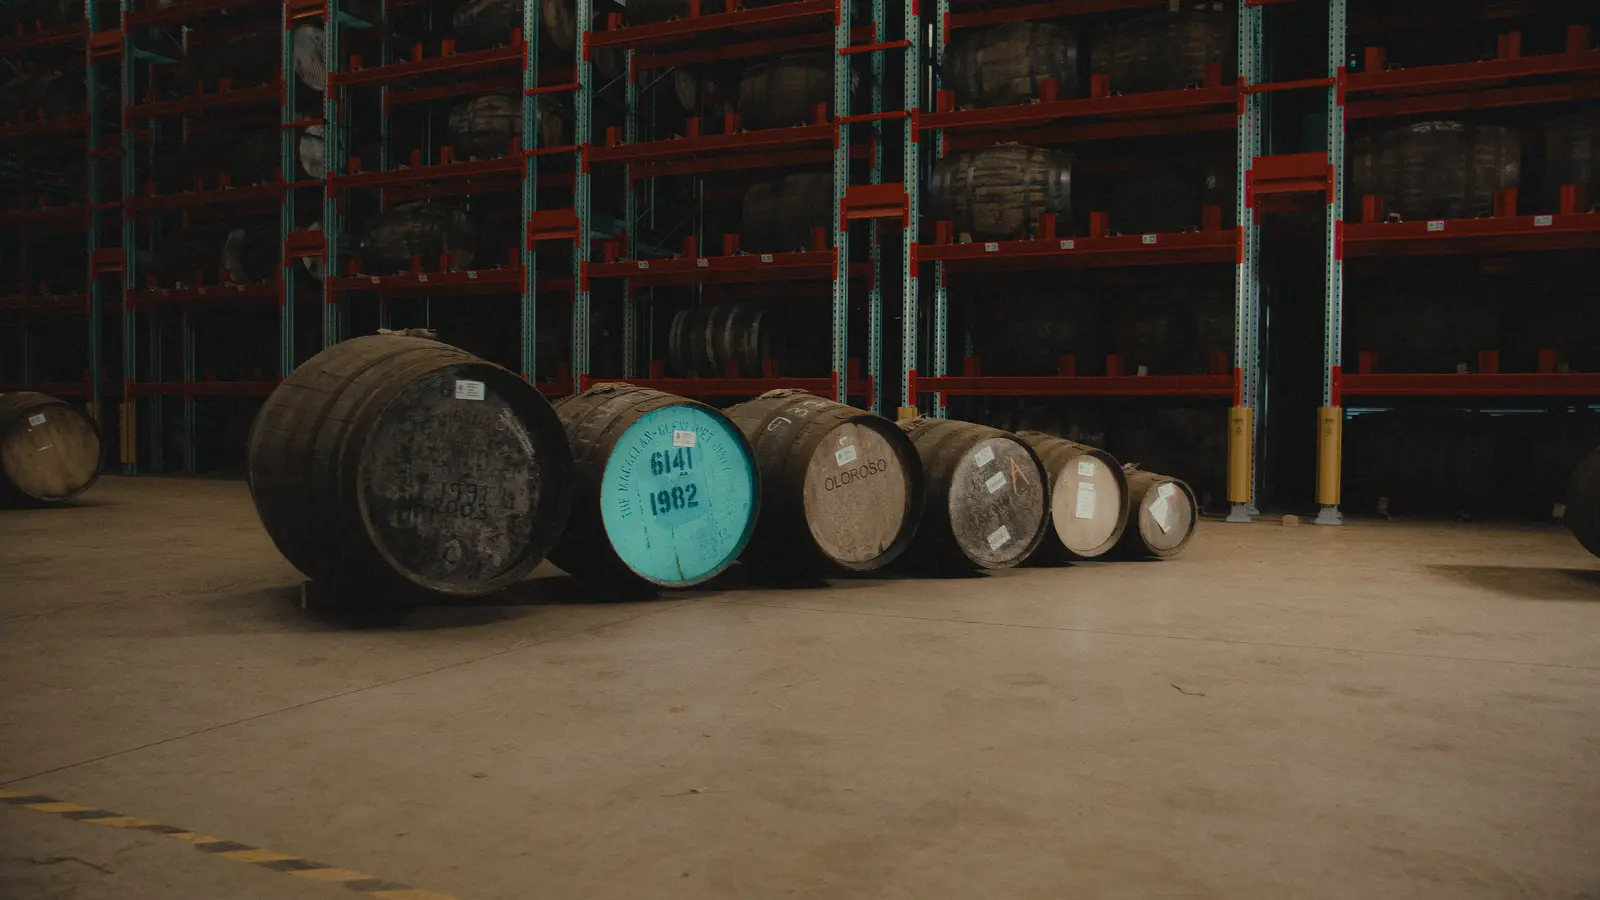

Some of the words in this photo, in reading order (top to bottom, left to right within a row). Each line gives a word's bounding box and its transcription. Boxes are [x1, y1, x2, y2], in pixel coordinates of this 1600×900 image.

[650, 446, 693, 477] 6141
[824, 458, 888, 492] OLOROSO
[649, 483, 699, 517] 1982
